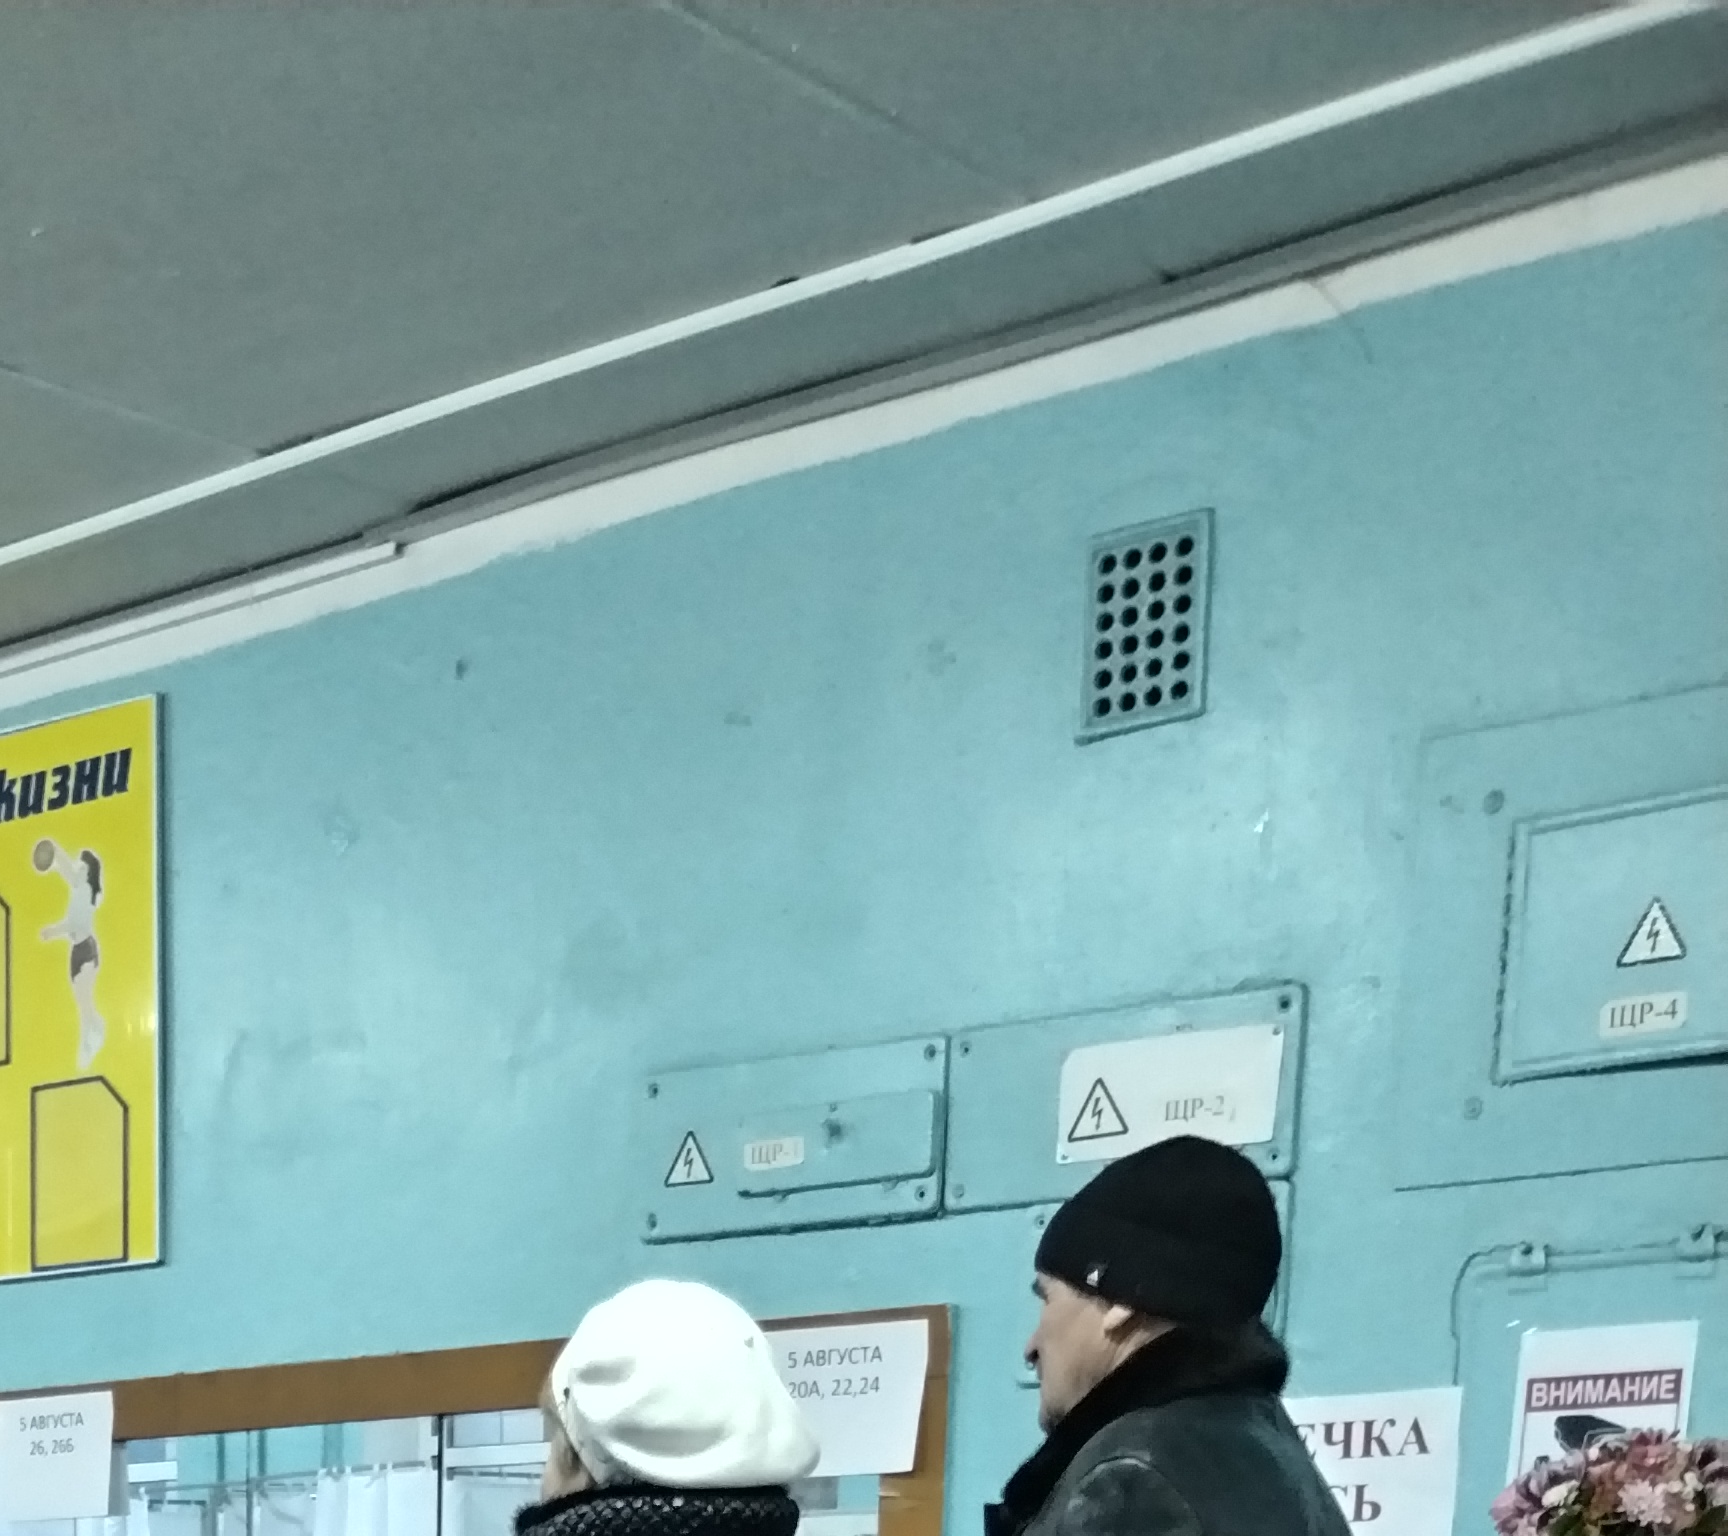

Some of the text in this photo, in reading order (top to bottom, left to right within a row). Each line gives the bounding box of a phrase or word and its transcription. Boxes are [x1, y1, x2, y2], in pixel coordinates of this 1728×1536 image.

[1608, 998, 1679, 1029] ЩР-4
[788, 1345, 883, 1369] 5 АВГУСТА
[1530, 1374, 1677, 1408] ВНИМАНИЕ
[19, 1411, 84, 1432] 5 АВГУСТА
